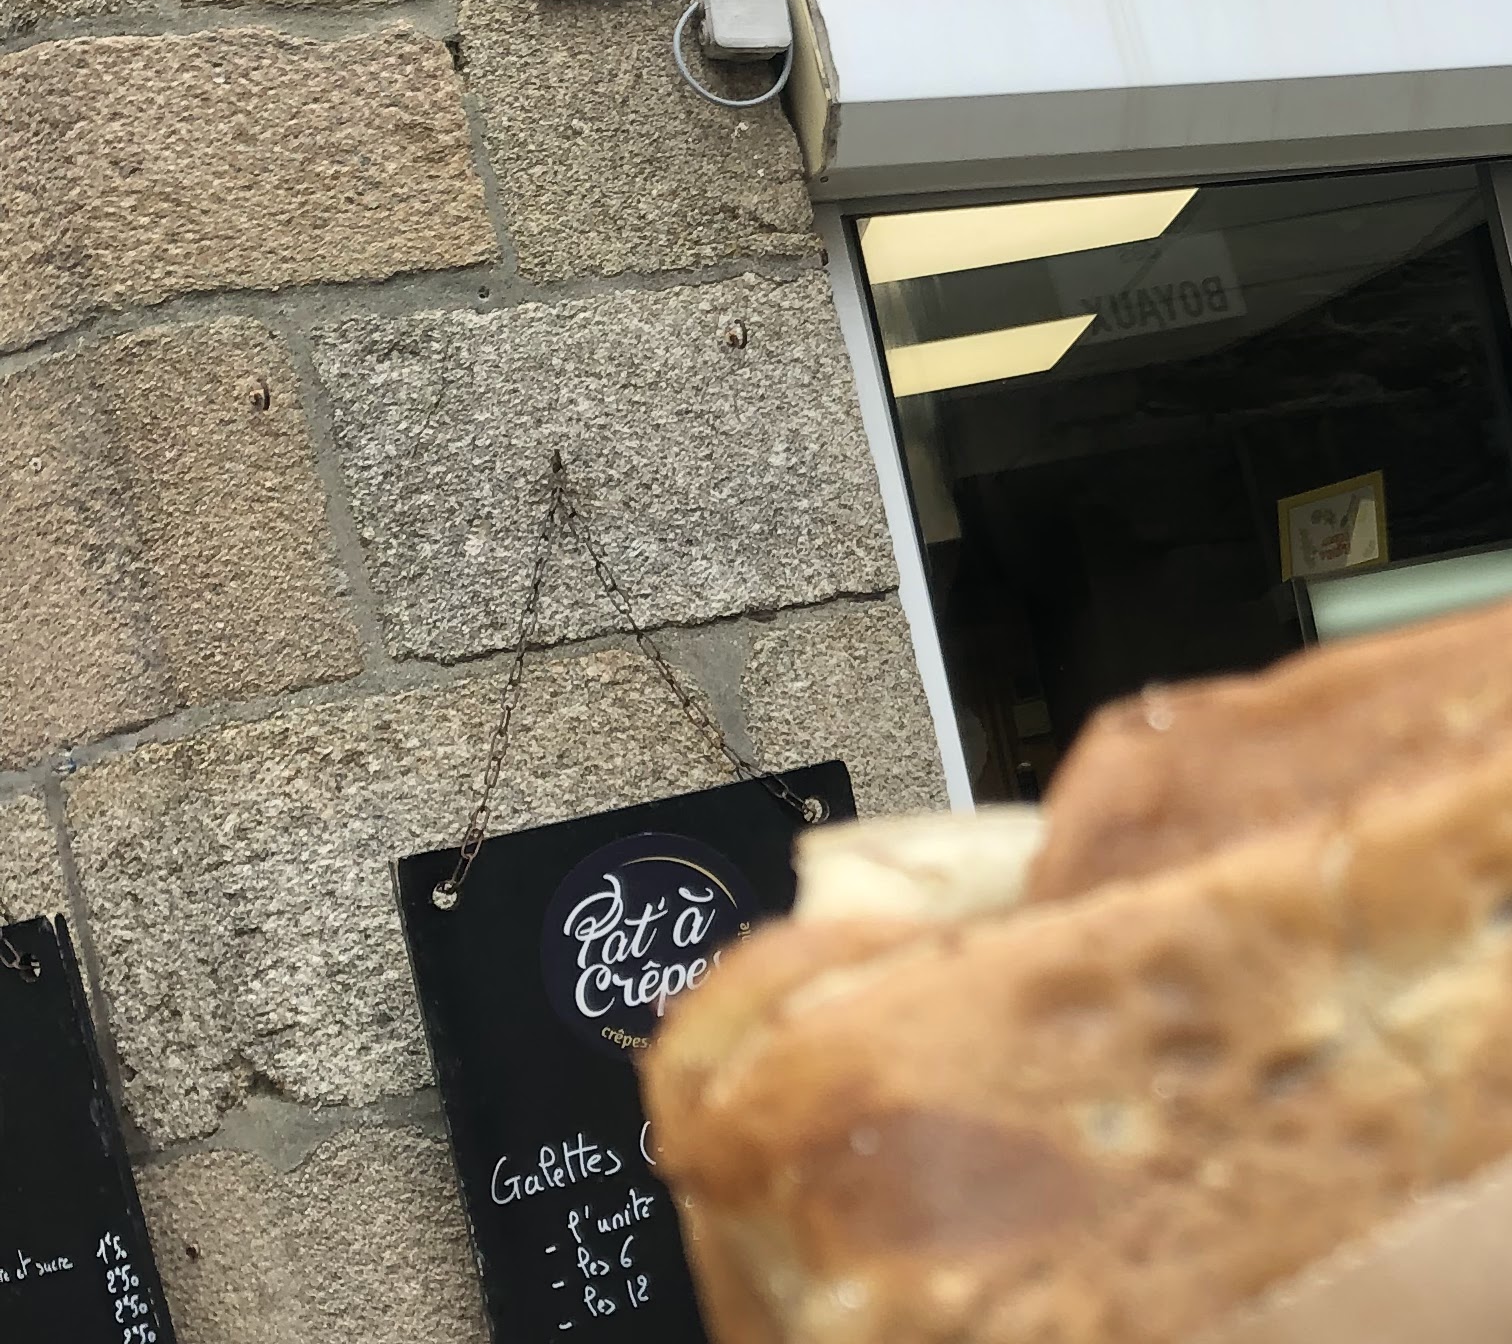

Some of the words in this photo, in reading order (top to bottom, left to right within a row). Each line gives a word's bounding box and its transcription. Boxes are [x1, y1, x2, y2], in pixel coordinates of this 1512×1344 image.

[492, 1133, 621, 1204] Galettes
[568, 1189, 654, 1244] l'unité
[578, 1247, 609, 1278] les
[621, 1235, 633, 1267] 6
[584, 1286, 615, 1316] les
[627, 1275, 648, 1307] 12
